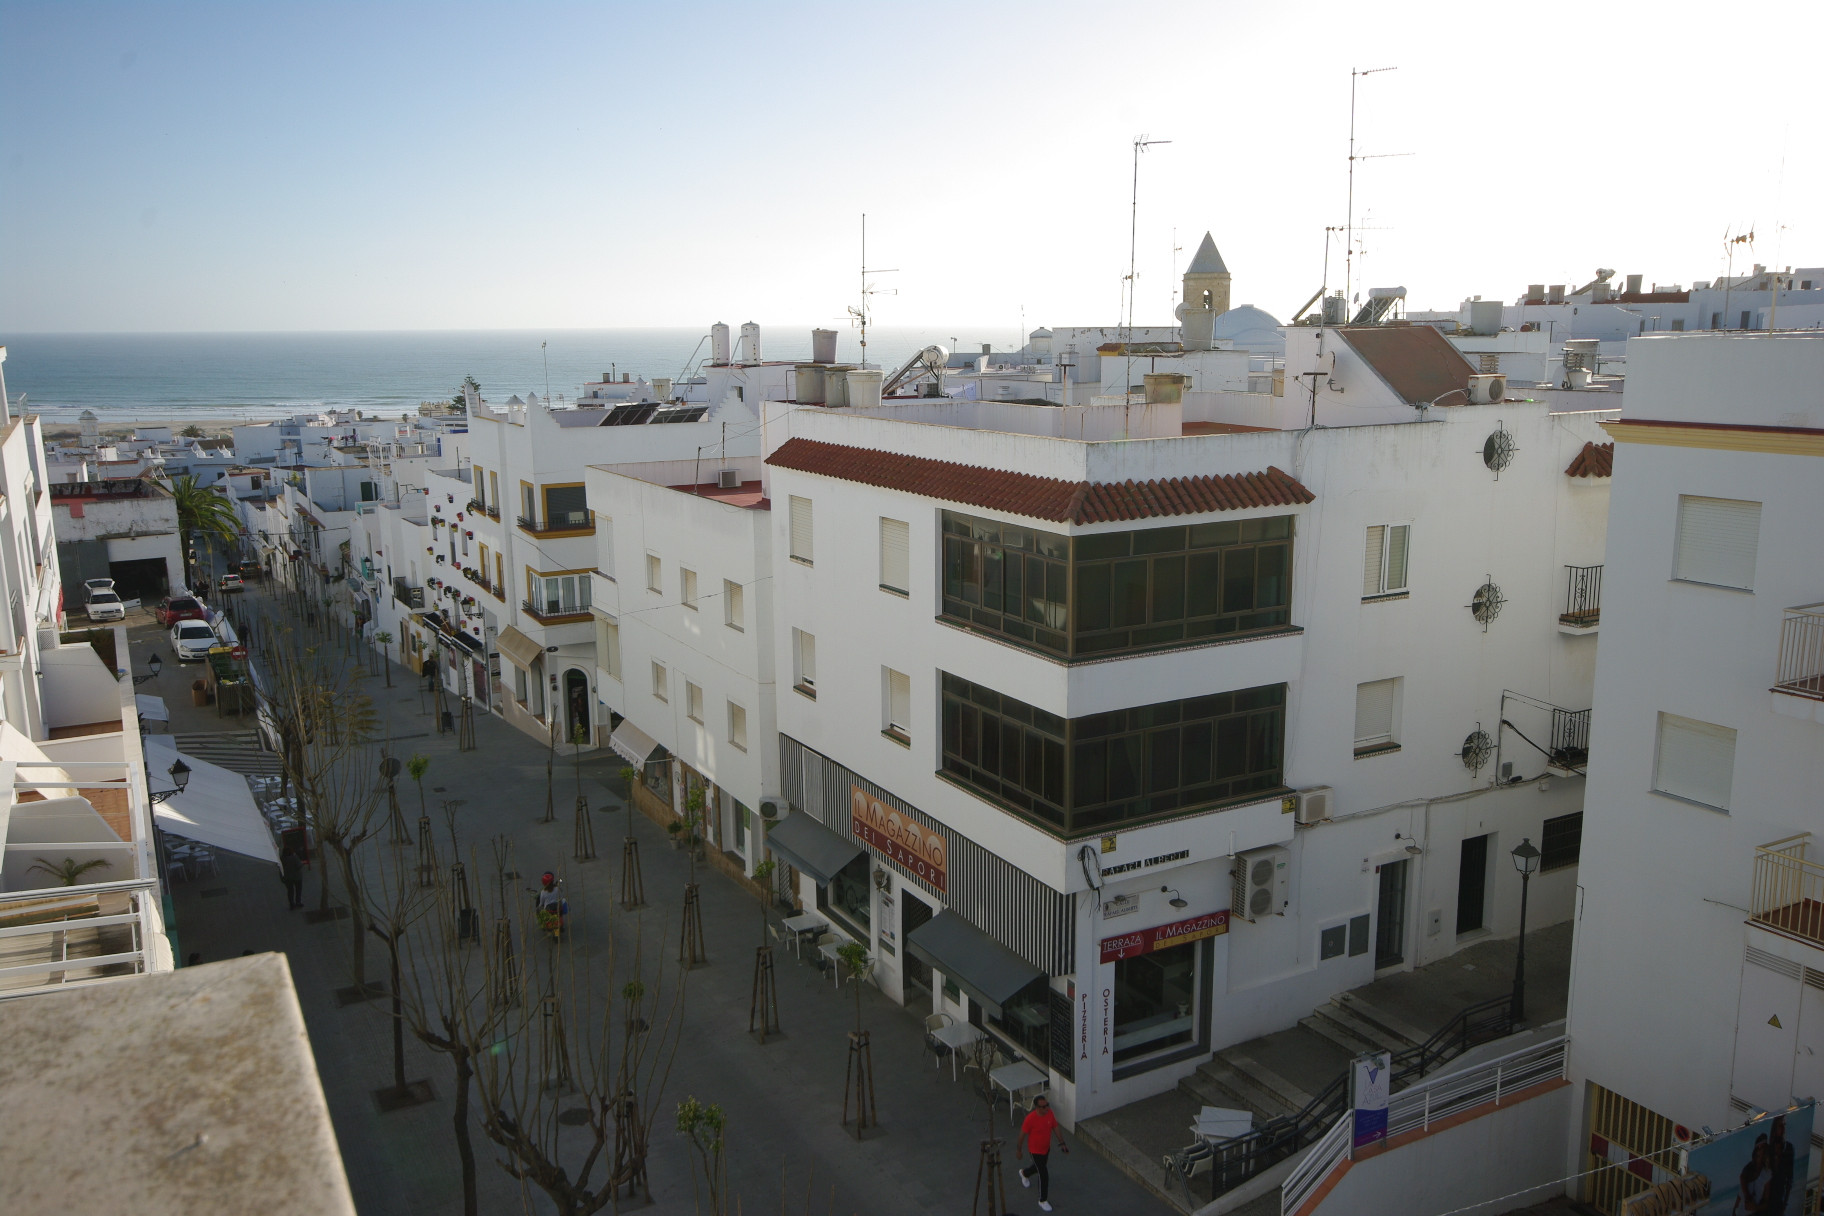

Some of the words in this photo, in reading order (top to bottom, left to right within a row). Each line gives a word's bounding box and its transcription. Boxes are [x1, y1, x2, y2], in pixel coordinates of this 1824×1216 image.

[854, 798, 863, 819] IL
[865, 802, 943, 867] MAGAZZINO
[854, 821, 876, 844] DEI
[886, 839, 944, 888] SAPORI
[1102, 861, 1142, 877] RAFAEL
[1144, 850, 1190, 866] ALBERTI
[1103, 935, 1142, 951] TERRAZA
[1155, 931, 1163, 940] IL
[1165, 915, 1225, 938] MAGAZZINO
[1155, 938, 1173, 949] DEI
[1183, 926, 1225, 942] SAPORI
[1080, 993, 1088, 1060] PIZZERIA
[1102, 988, 1110, 1056] OSTERIA
